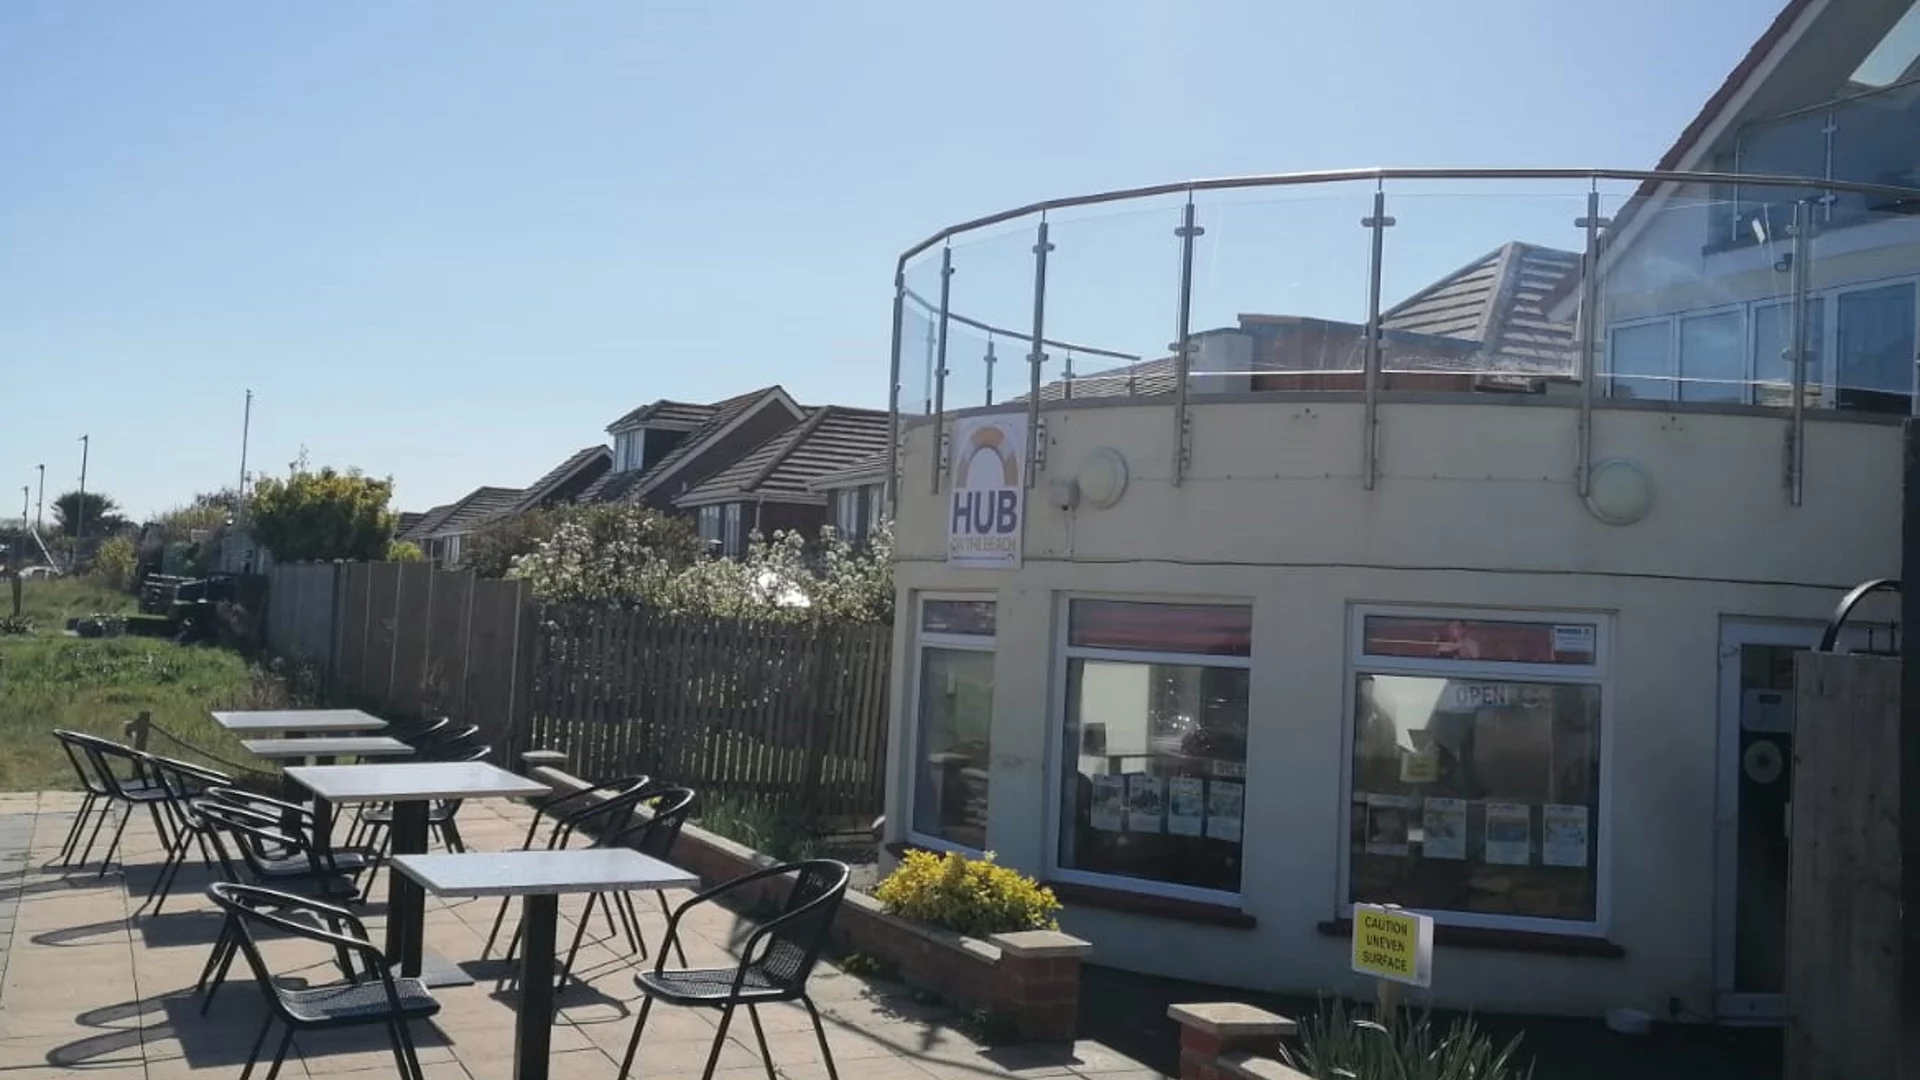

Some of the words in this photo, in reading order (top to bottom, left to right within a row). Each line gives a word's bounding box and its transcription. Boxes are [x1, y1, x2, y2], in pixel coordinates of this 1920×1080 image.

[952, 490, 1018, 535] HUB
[964, 536, 982, 551] THE
[984, 536, 1016, 552] BEACH
[1456, 684, 1510, 706] OPEN
[1365, 916, 1408, 936] CAUTION
[1366, 934, 1406, 952] UNEVEN
[1362, 950, 1408, 972] SURFACE
